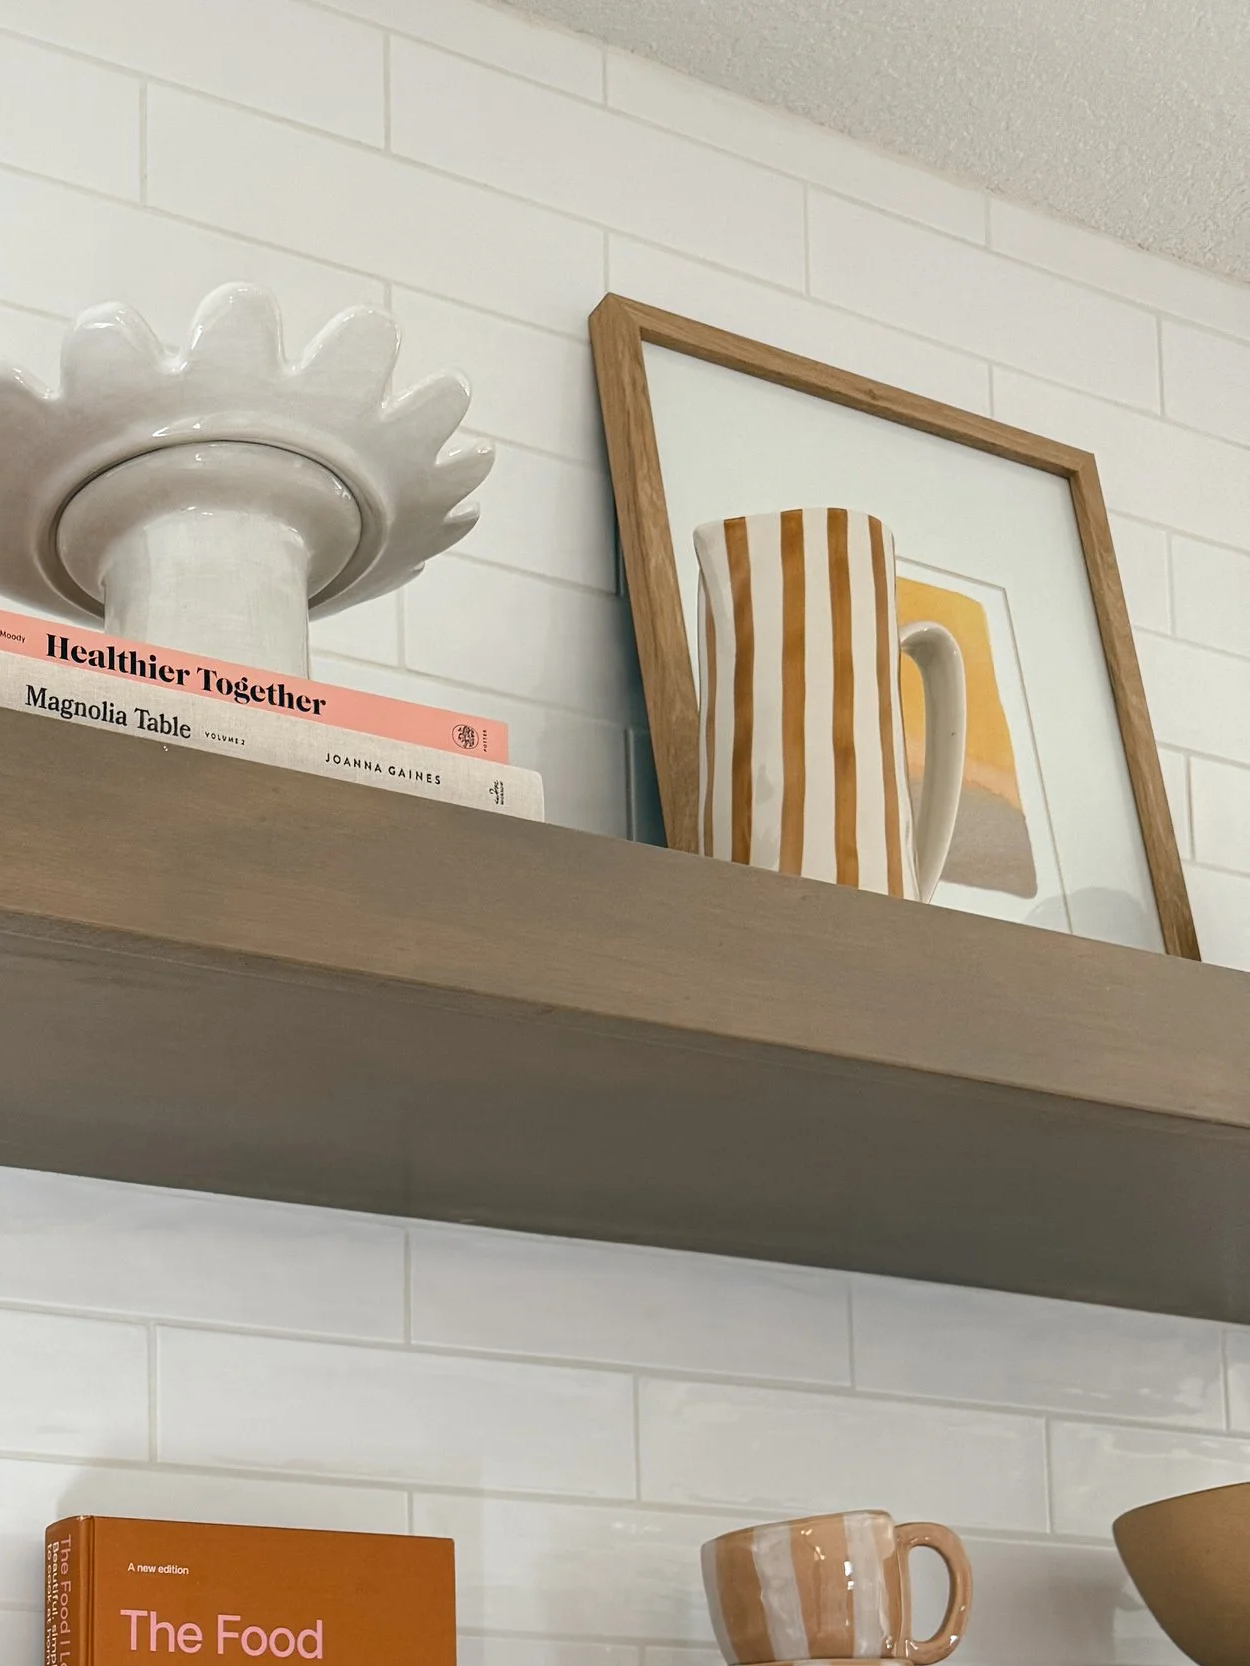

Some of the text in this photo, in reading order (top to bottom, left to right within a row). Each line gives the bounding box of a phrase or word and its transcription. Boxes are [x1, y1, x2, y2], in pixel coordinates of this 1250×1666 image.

[0, 630, 26, 643] Moody
[45, 633, 327, 716] Healthier Together
[24, 684, 192, 740] Magnolia Table
[204, 731, 239, 745] VOLUME
[325, 753, 441, 785] JOANNA GAINES
[60, 1534, 72, 1575] The
[127, 1562, 190, 1575] A new edition
[51, 1541, 60, 1620] Beautiful,
[60, 1580, 72, 1634] Food
[120, 1609, 323, 1659] The Food
